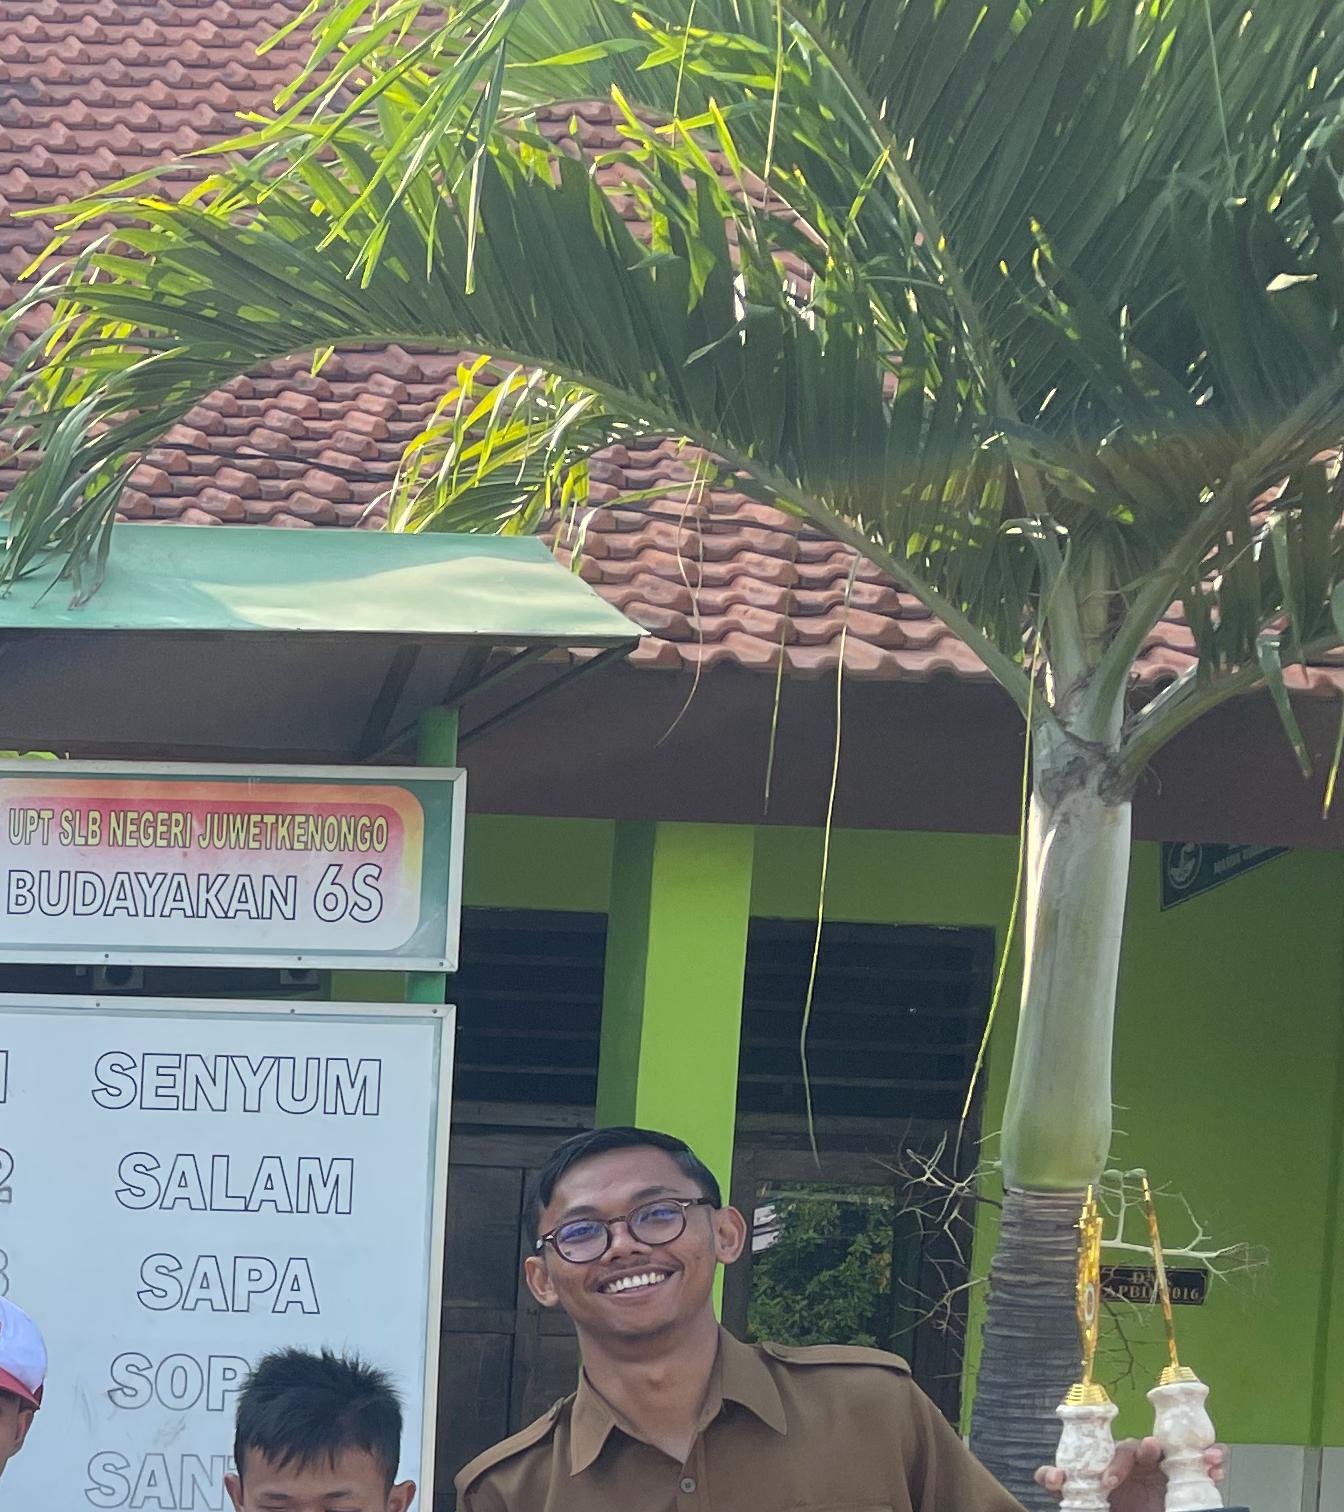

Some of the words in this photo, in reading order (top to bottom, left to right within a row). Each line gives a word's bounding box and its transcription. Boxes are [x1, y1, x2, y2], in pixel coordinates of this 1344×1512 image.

[8, 808, 55, 846] UPT
[59, 809, 102, 847] SLB
[108, 810, 193, 849] NEGERI
[198, 812, 389, 852] JUWETKENONGO
[6, 869, 298, 921] BUDAYAKAN
[314, 862, 384, 924] 6S
[90, 1051, 382, 1116] SENYUM
[114, 1152, 354, 1215] SALAM
[136, 1253, 320, 1314] SAPA
[107, 1351, 253, 1412] SOP
[84, 1450, 237, 1512] SAN
